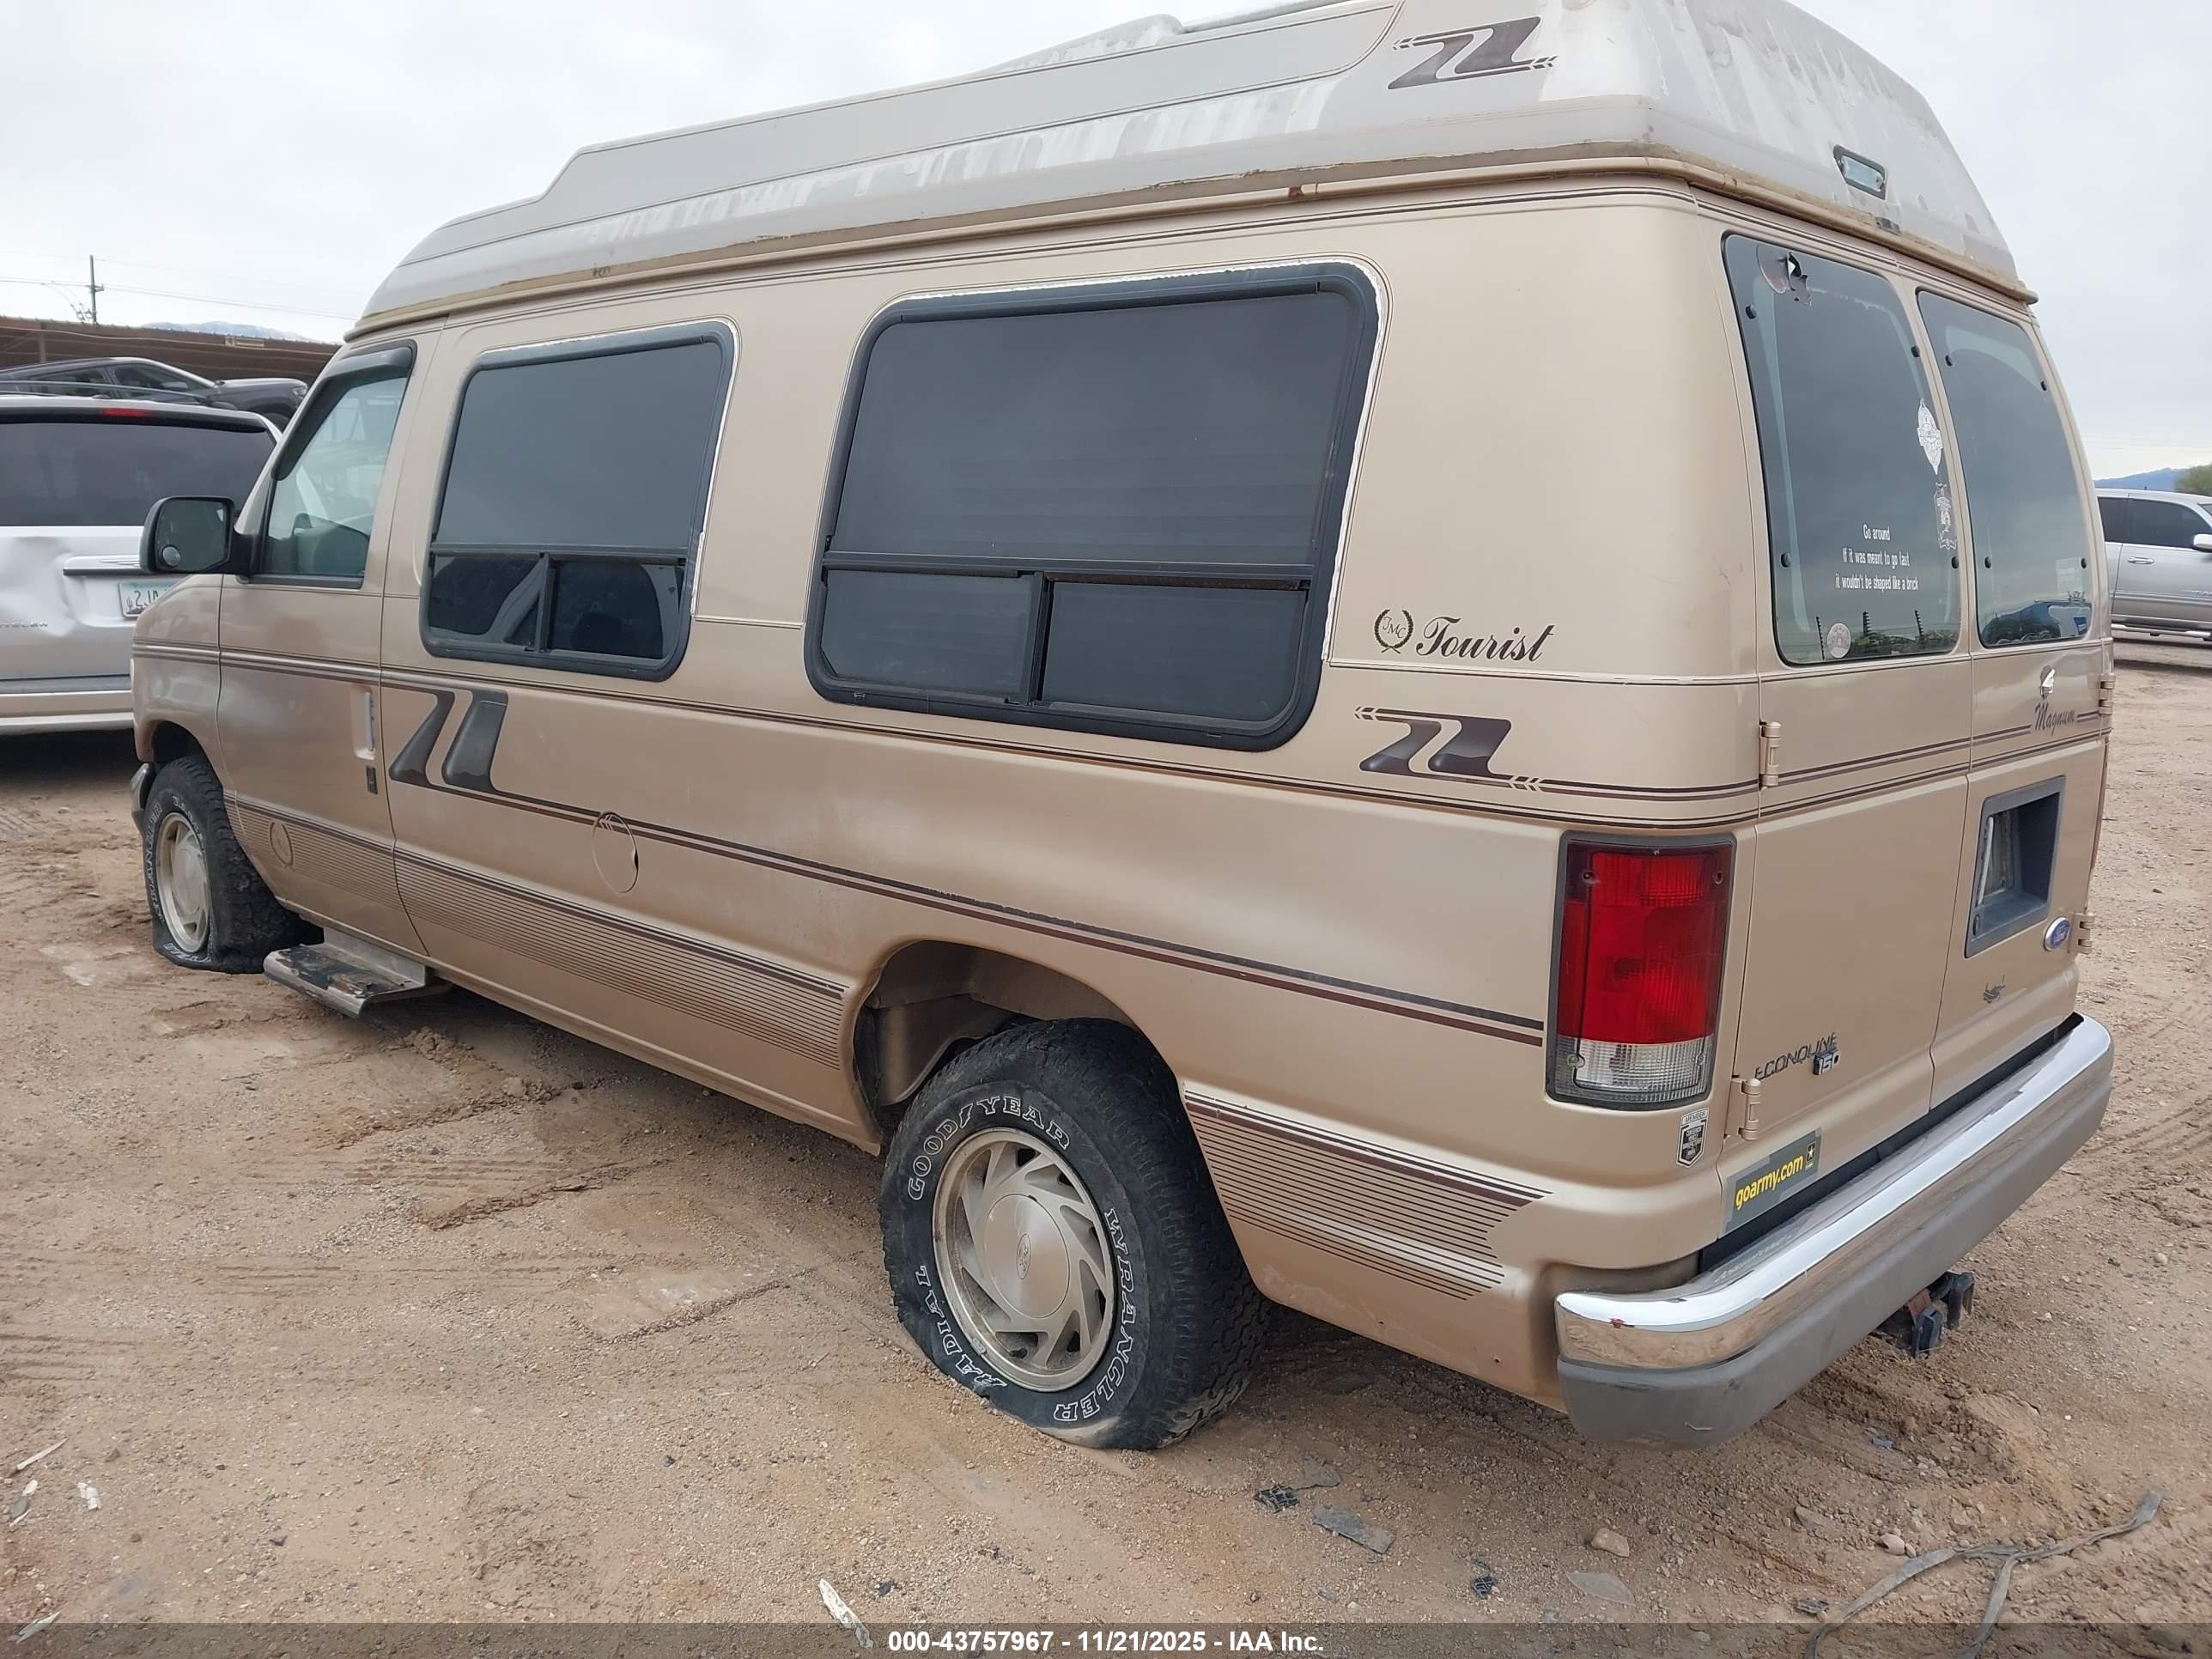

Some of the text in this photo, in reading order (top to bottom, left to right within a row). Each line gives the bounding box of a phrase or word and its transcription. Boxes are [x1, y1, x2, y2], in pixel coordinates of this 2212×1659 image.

[1863, 524, 1891, 541] Go around
[1848, 548, 1854, 563] it
[1854, 552, 1866, 564] was
[1867, 550, 1883, 565] meant
[1884, 550, 1891, 565] to
[1891, 554, 1899, 569] go
[1835, 573, 1919, 593] it wouldn't be shaped like a brick
[1416, 617, 1554, 662] Tourist
[2034, 702, 2075, 736] Magnum
[1753, 1031, 1838, 1081] ECONOLINE
[1735, 1155, 1804, 1212] goarmy.com
[915, 1265, 1008, 1388] RADIAL
[1053, 1207, 1137, 1422] WRANGLER
